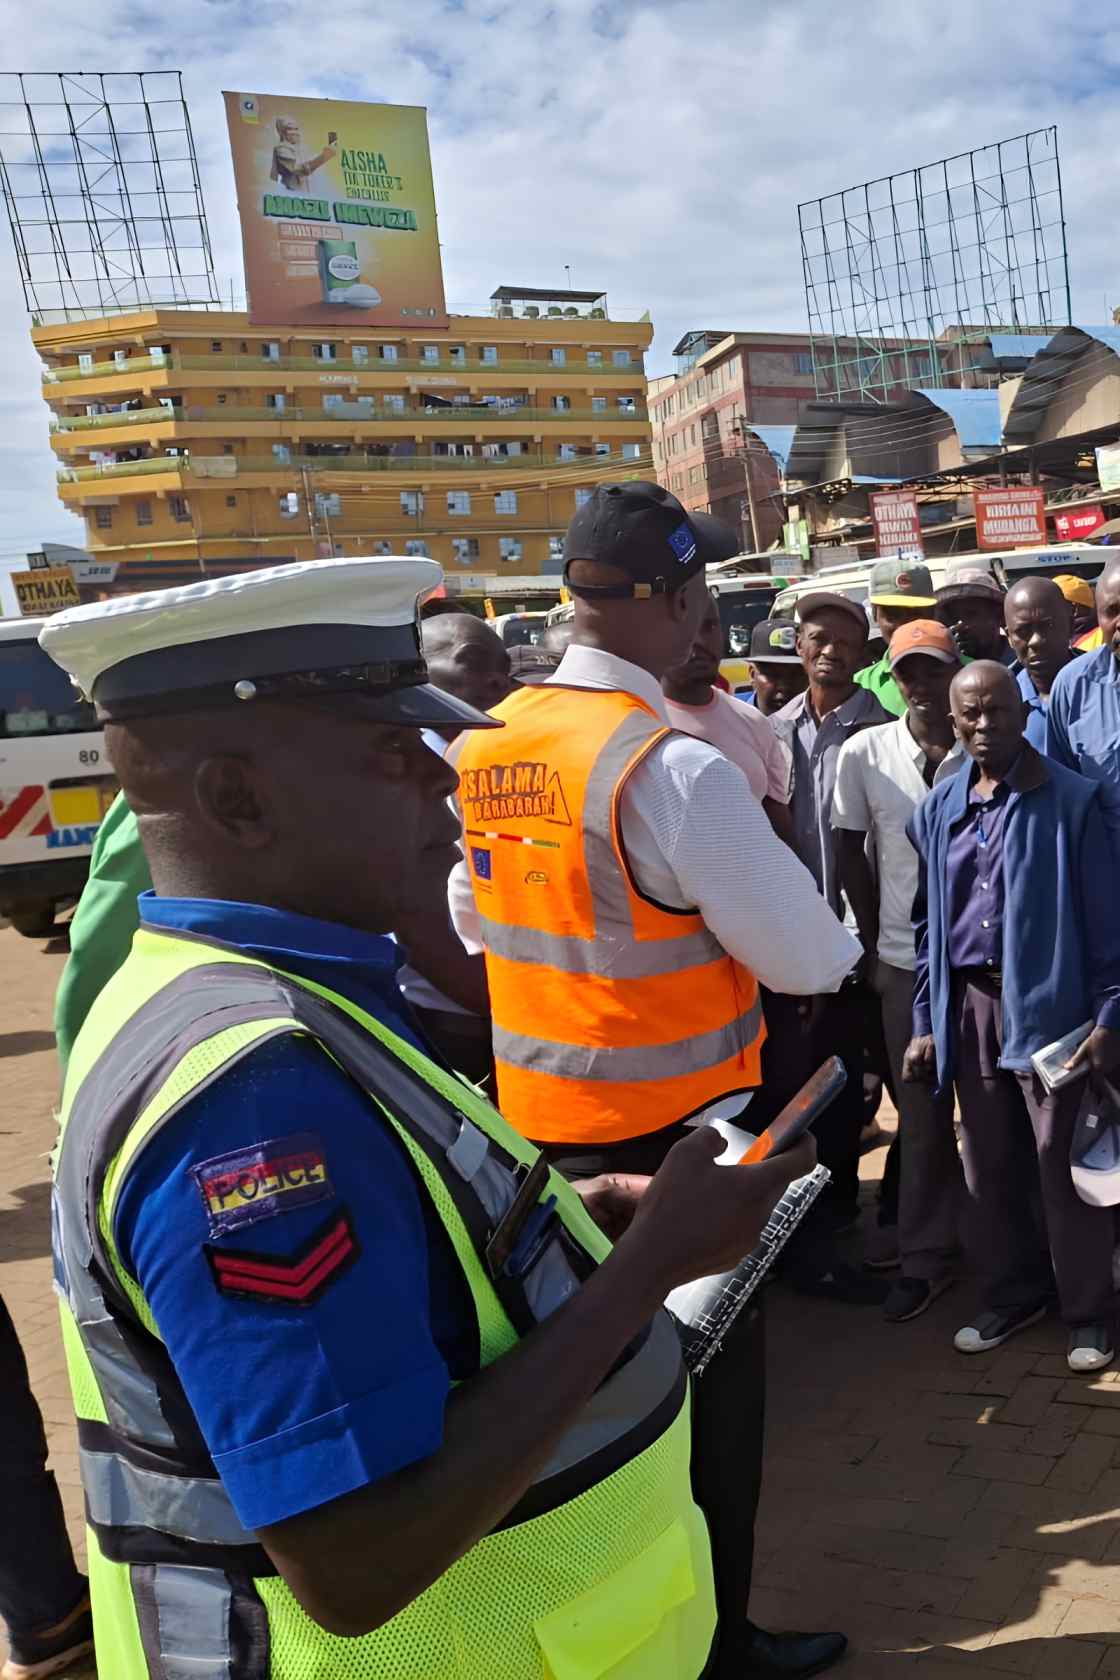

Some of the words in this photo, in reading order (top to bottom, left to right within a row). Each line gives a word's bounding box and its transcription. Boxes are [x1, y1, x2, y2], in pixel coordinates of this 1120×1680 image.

[341, 150, 388, 174] AISHA
[17, 577, 80, 602] OTHAYA
[79, 750, 100, 763] 80
[212, 1158, 326, 1209] POLICE
